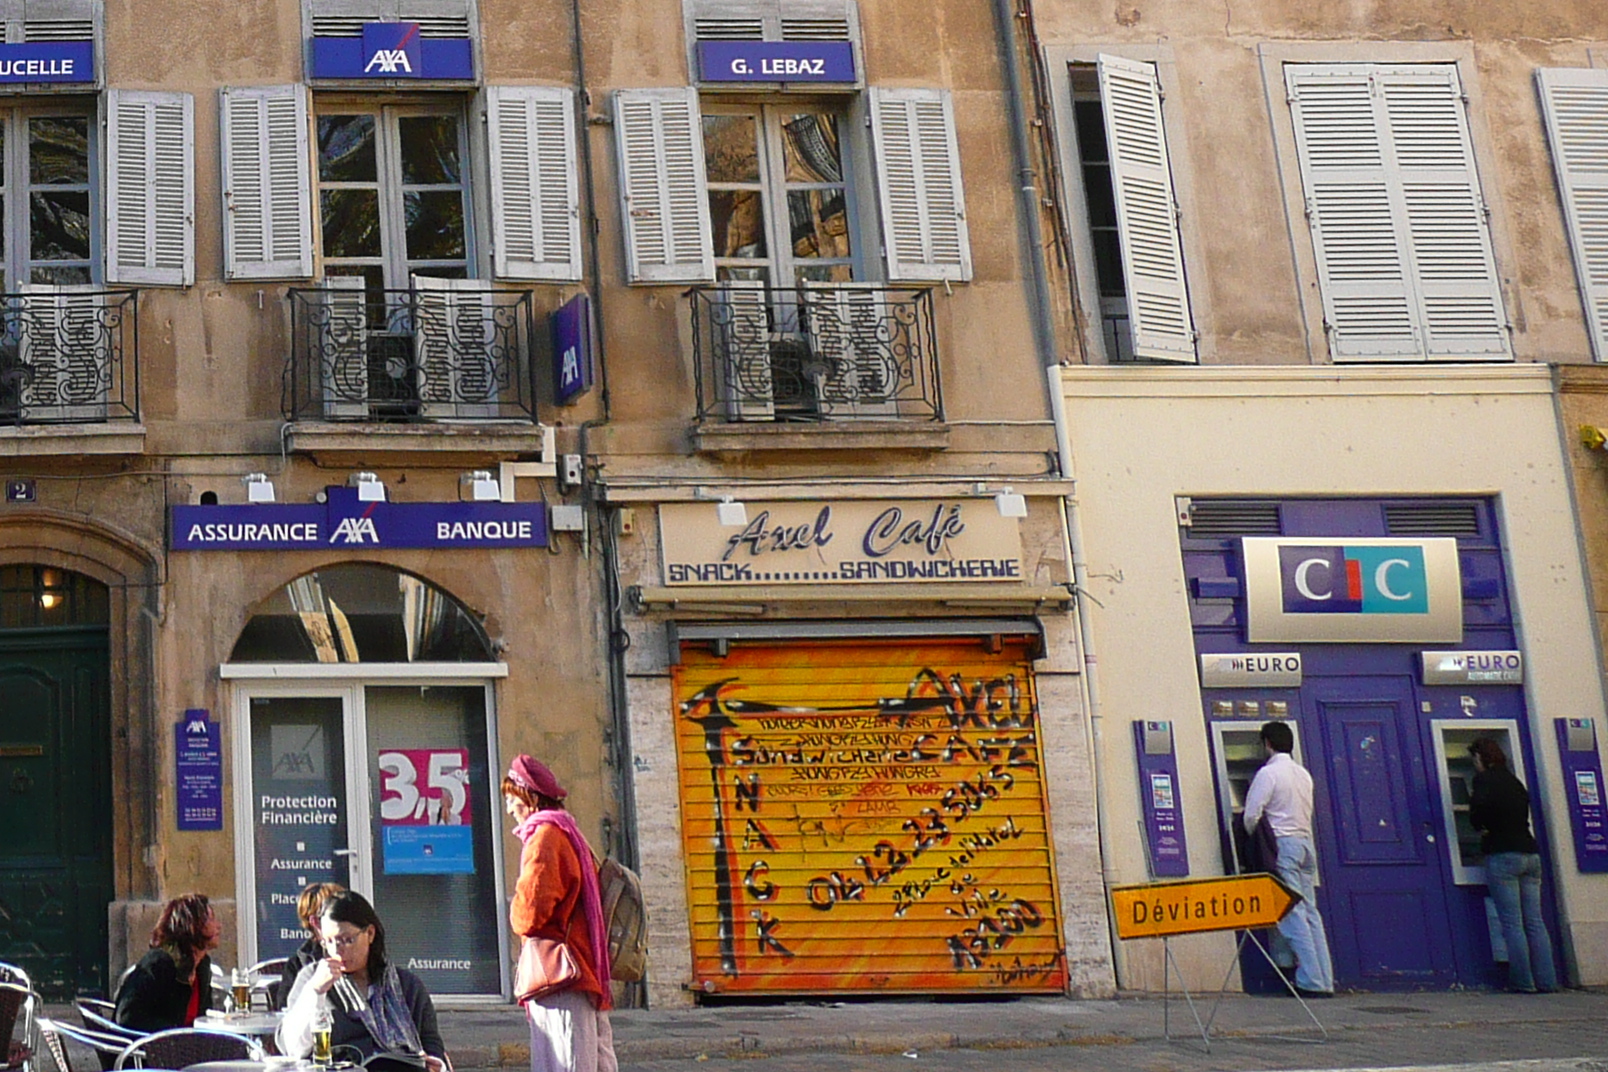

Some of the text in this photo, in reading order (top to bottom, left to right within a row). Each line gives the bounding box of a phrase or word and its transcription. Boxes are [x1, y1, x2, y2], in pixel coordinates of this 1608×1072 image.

[364, 49, 412, 73] AXA
[730, 58, 826, 75] G. LEBAZ
[15, 483, 27, 499] 2
[187, 518, 532, 544] ASSURANCE AXA BANQUE
[722, 503, 966, 562] Axel Café
[1294, 558, 1413, 601] CIC
[1245, 657, 1300, 672] EURO
[1466, 655, 1520, 669] EURO
[261, 794, 338, 809] Protection
[261, 809, 338, 825] Financière
[271, 857, 333, 870] Assurance
[1132, 893, 1261, 925] Déviation
[407, 957, 471, 970] Assurance
